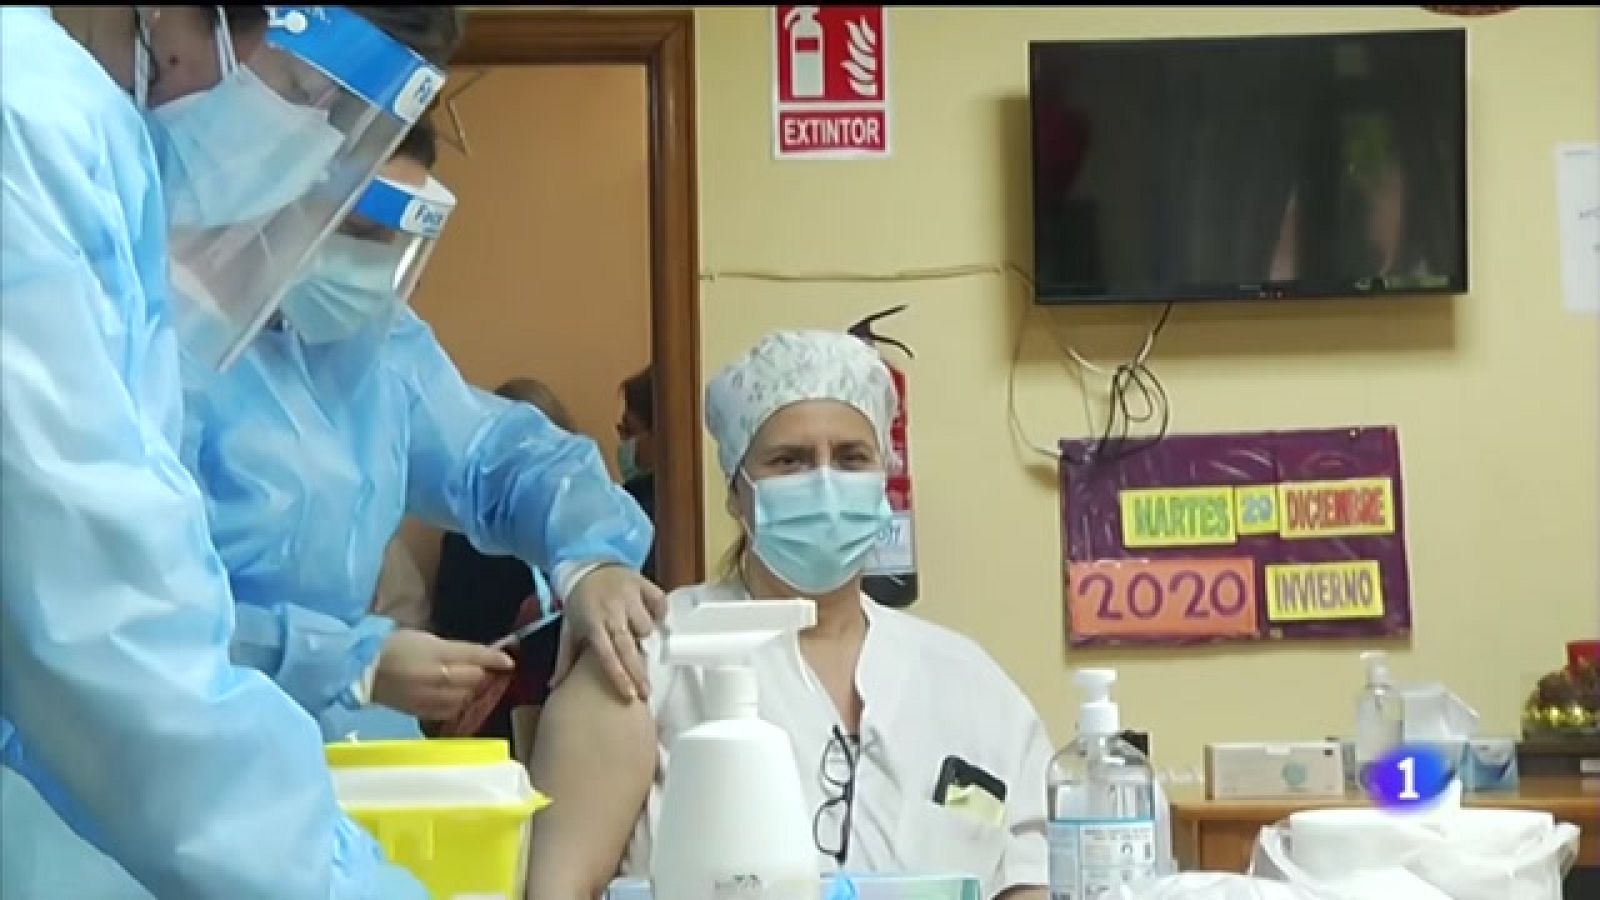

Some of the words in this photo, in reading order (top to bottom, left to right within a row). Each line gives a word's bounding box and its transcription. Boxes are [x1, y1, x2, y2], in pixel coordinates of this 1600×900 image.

[783, 116, 882, 146] EXTINTOR
[1134, 495, 1231, 538] MARTES
[1287, 487, 1386, 531] DICIEMBRE
[1077, 570, 1247, 621] 2020
[1275, 568, 1373, 613] INVIERNO
